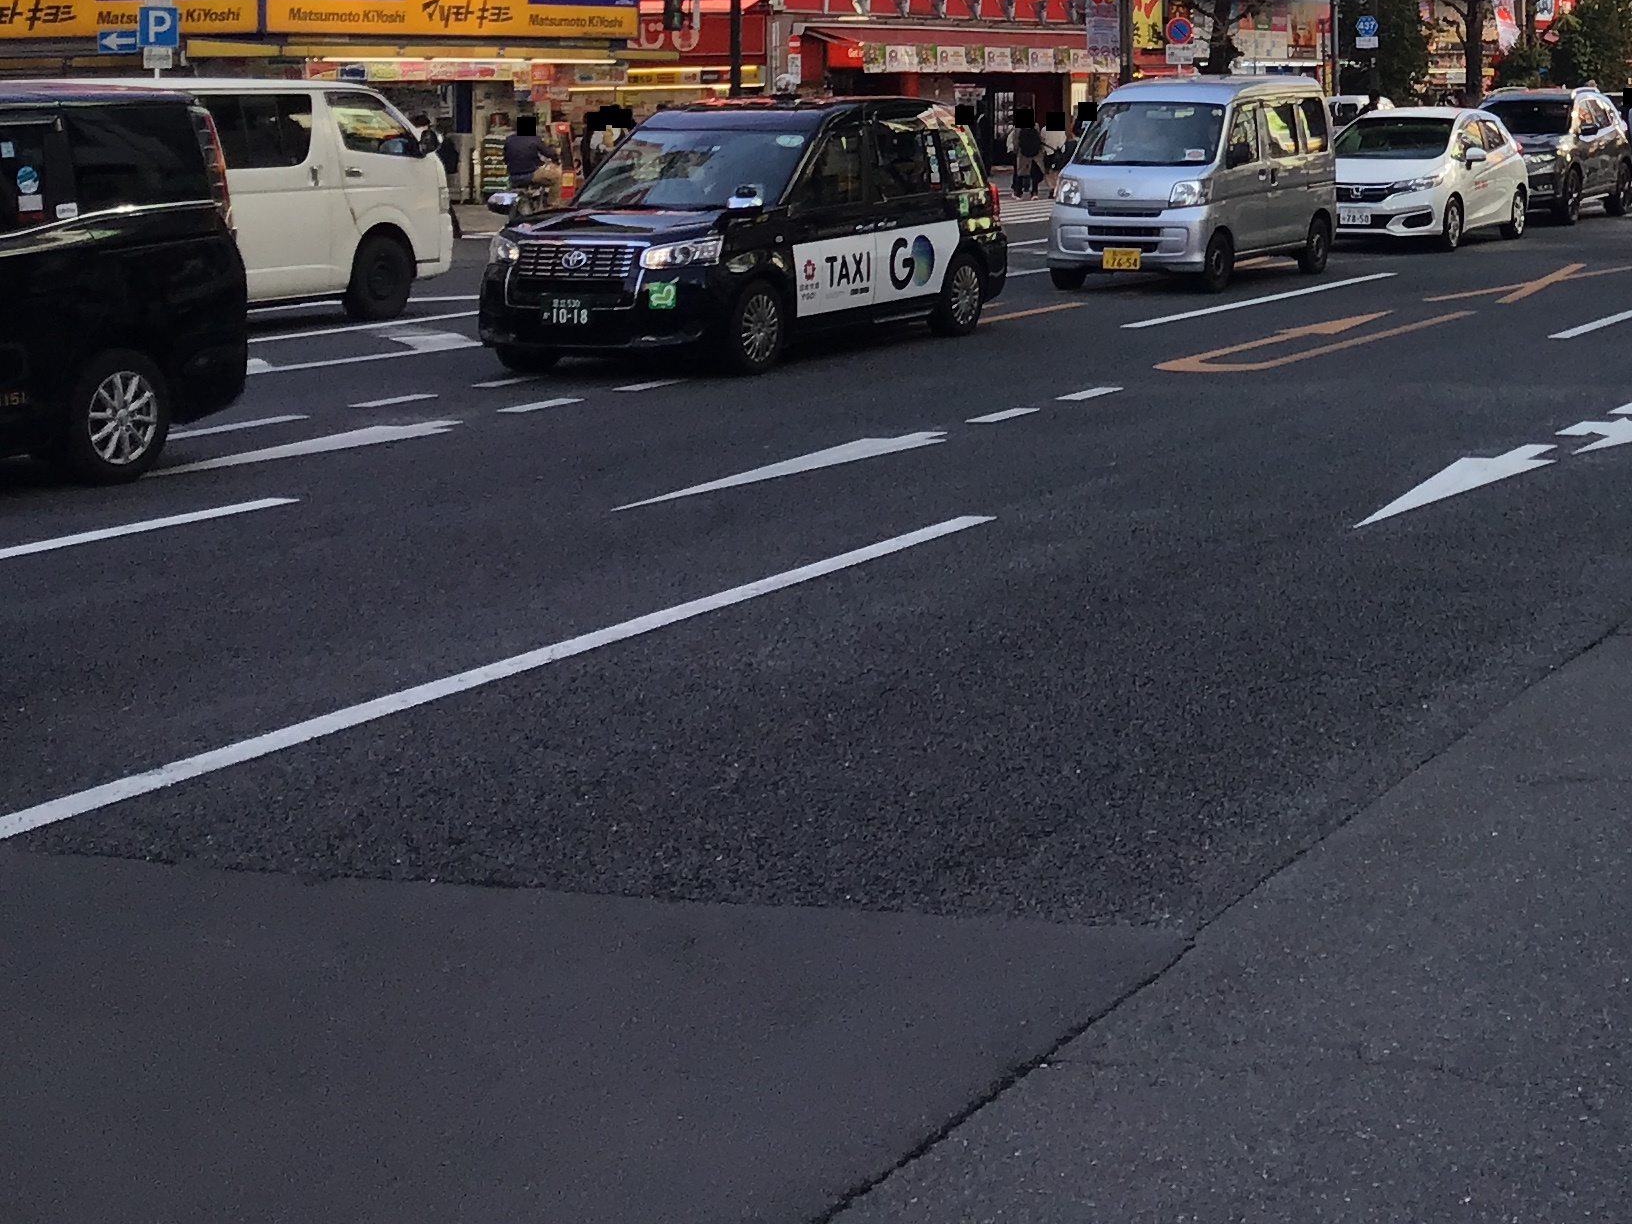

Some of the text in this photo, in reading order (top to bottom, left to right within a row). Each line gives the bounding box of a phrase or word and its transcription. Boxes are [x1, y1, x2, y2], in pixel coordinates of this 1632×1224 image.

[185, 7, 241, 23] KiYoshi
[288, 6, 407, 25] Matsumoto KiYoshi
[528, 13, 624, 29] Matsumoto KiYoshi
[149, 10, 172, 43] P
[825, 251, 871, 288] TAXI
[889, 234, 935, 291] GO
[552, 308, 588, 324] 10-18
